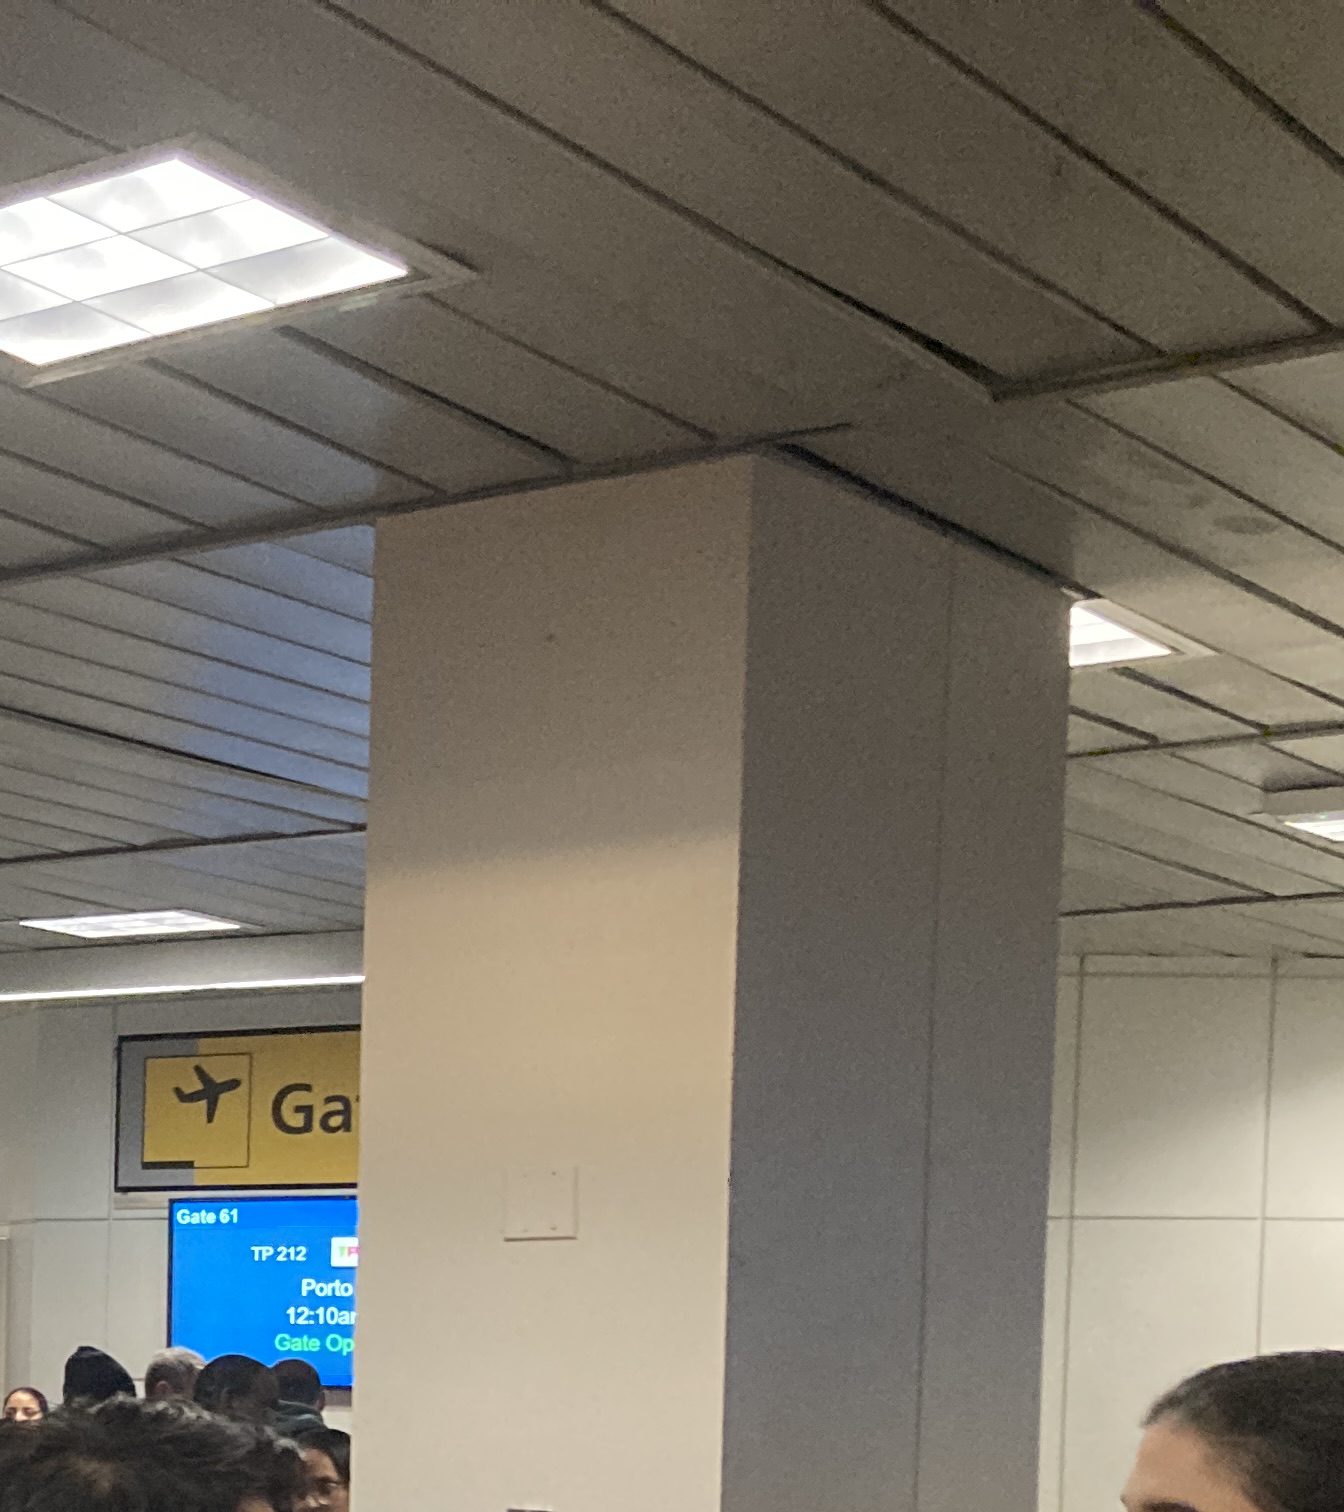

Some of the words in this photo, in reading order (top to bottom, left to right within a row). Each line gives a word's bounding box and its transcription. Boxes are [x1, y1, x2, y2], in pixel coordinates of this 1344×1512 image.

[271, 1082, 360, 1135] Ga
[176, 1208, 217, 1225] Gate
[220, 1208, 239, 1223] 61
[251, 1246, 274, 1262] TP
[276, 1246, 307, 1262] 212
[301, 1277, 353, 1298] Porto
[274, 1333, 321, 1351] Gate
